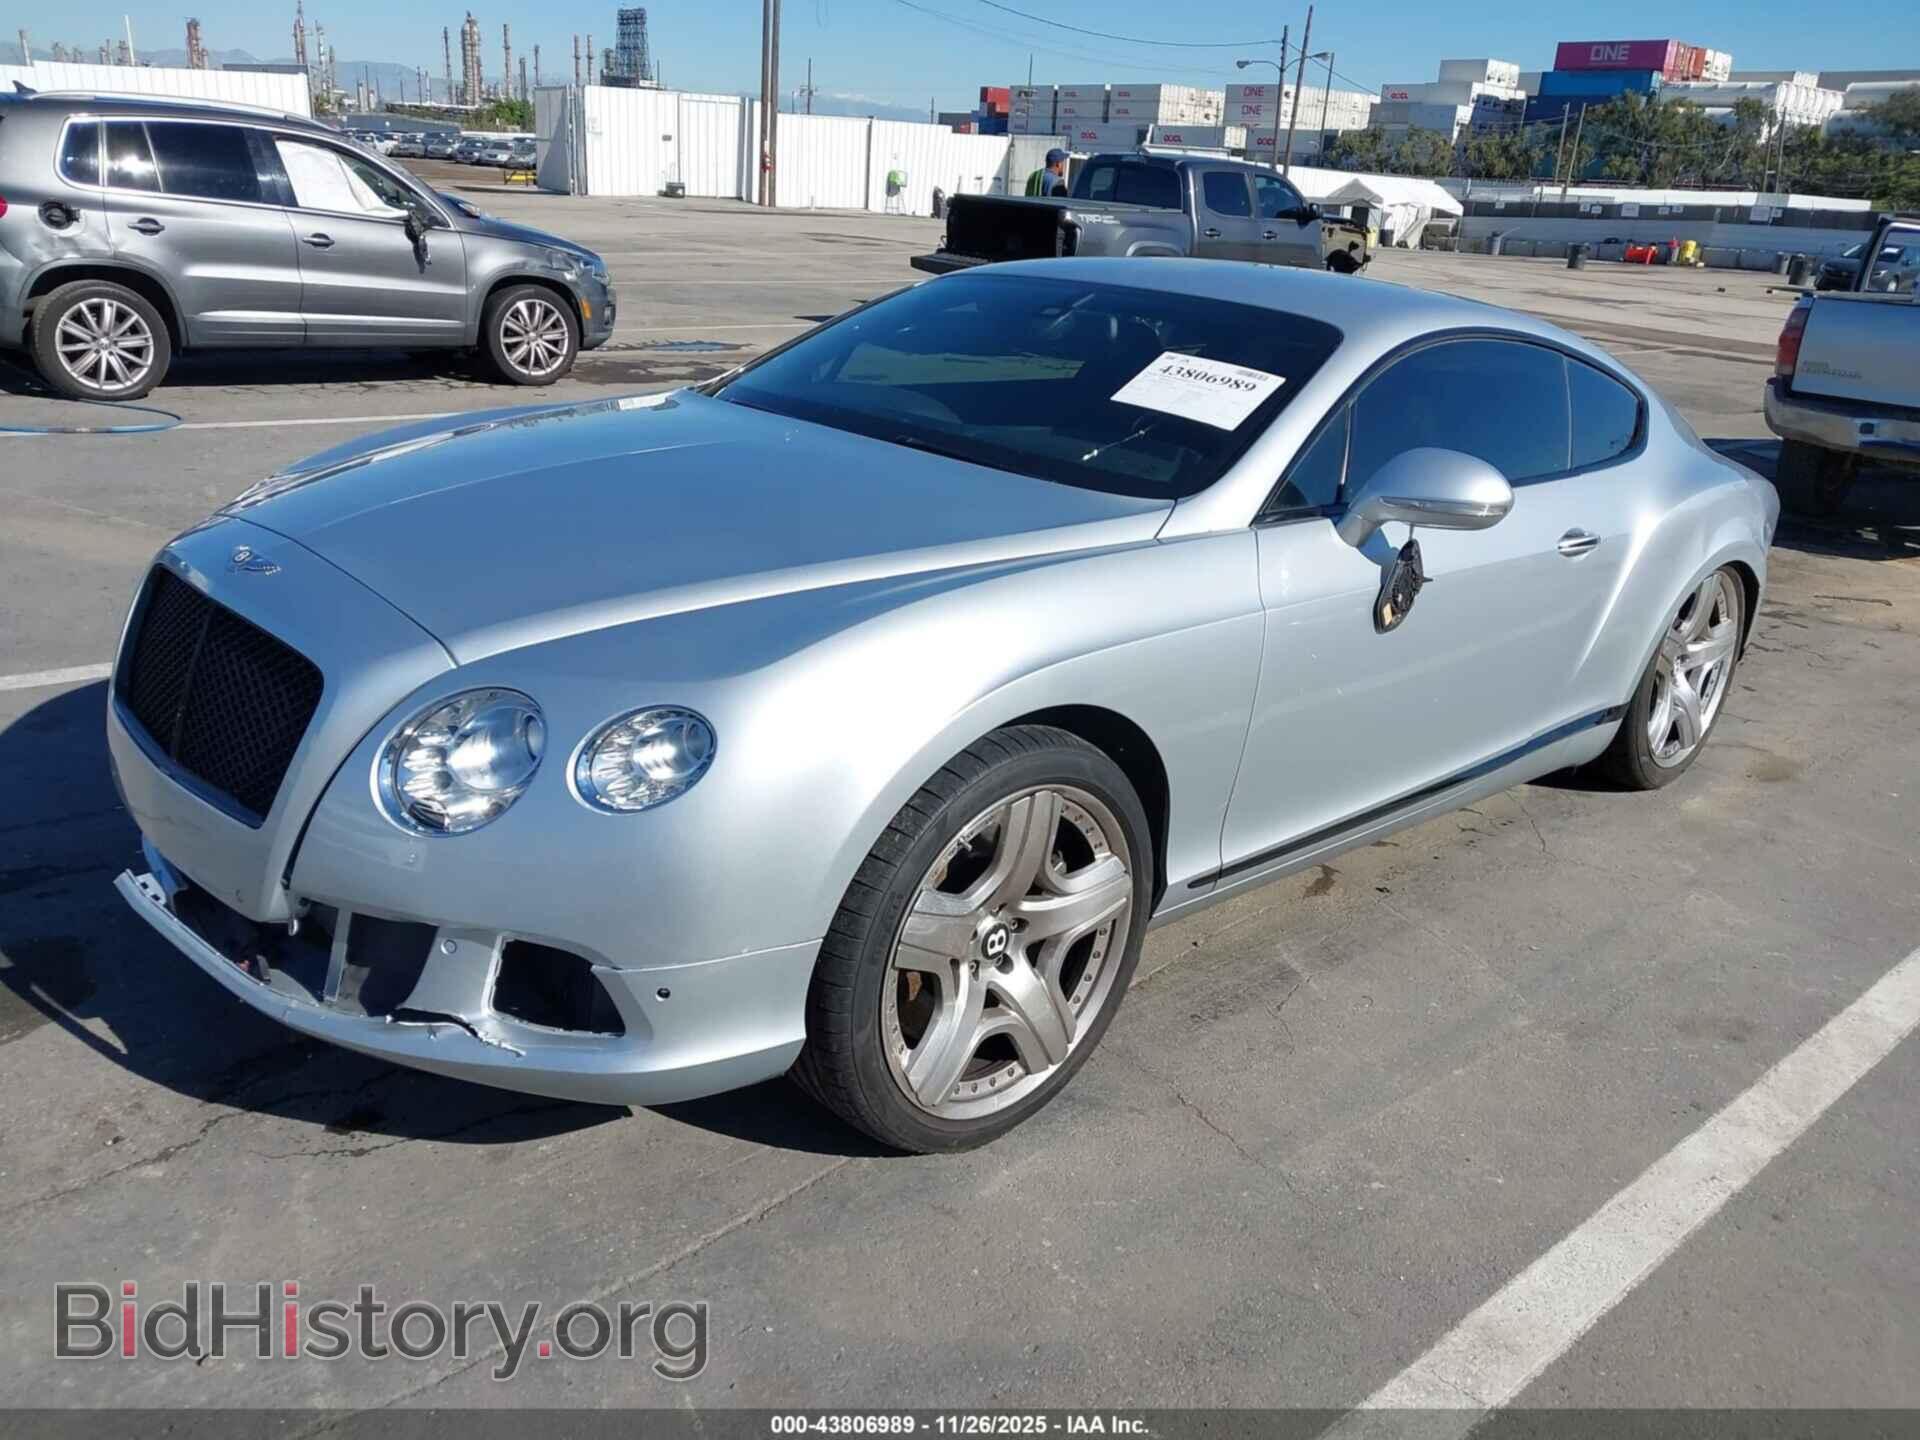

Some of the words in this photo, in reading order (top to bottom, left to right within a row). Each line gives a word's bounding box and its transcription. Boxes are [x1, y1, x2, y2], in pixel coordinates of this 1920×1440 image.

[1590, 45, 1630, 61] ONE
[1243, 86, 1264, 97] ONE
[1242, 104, 1262, 115] ONE
[1160, 364, 1257, 392] 43806989
